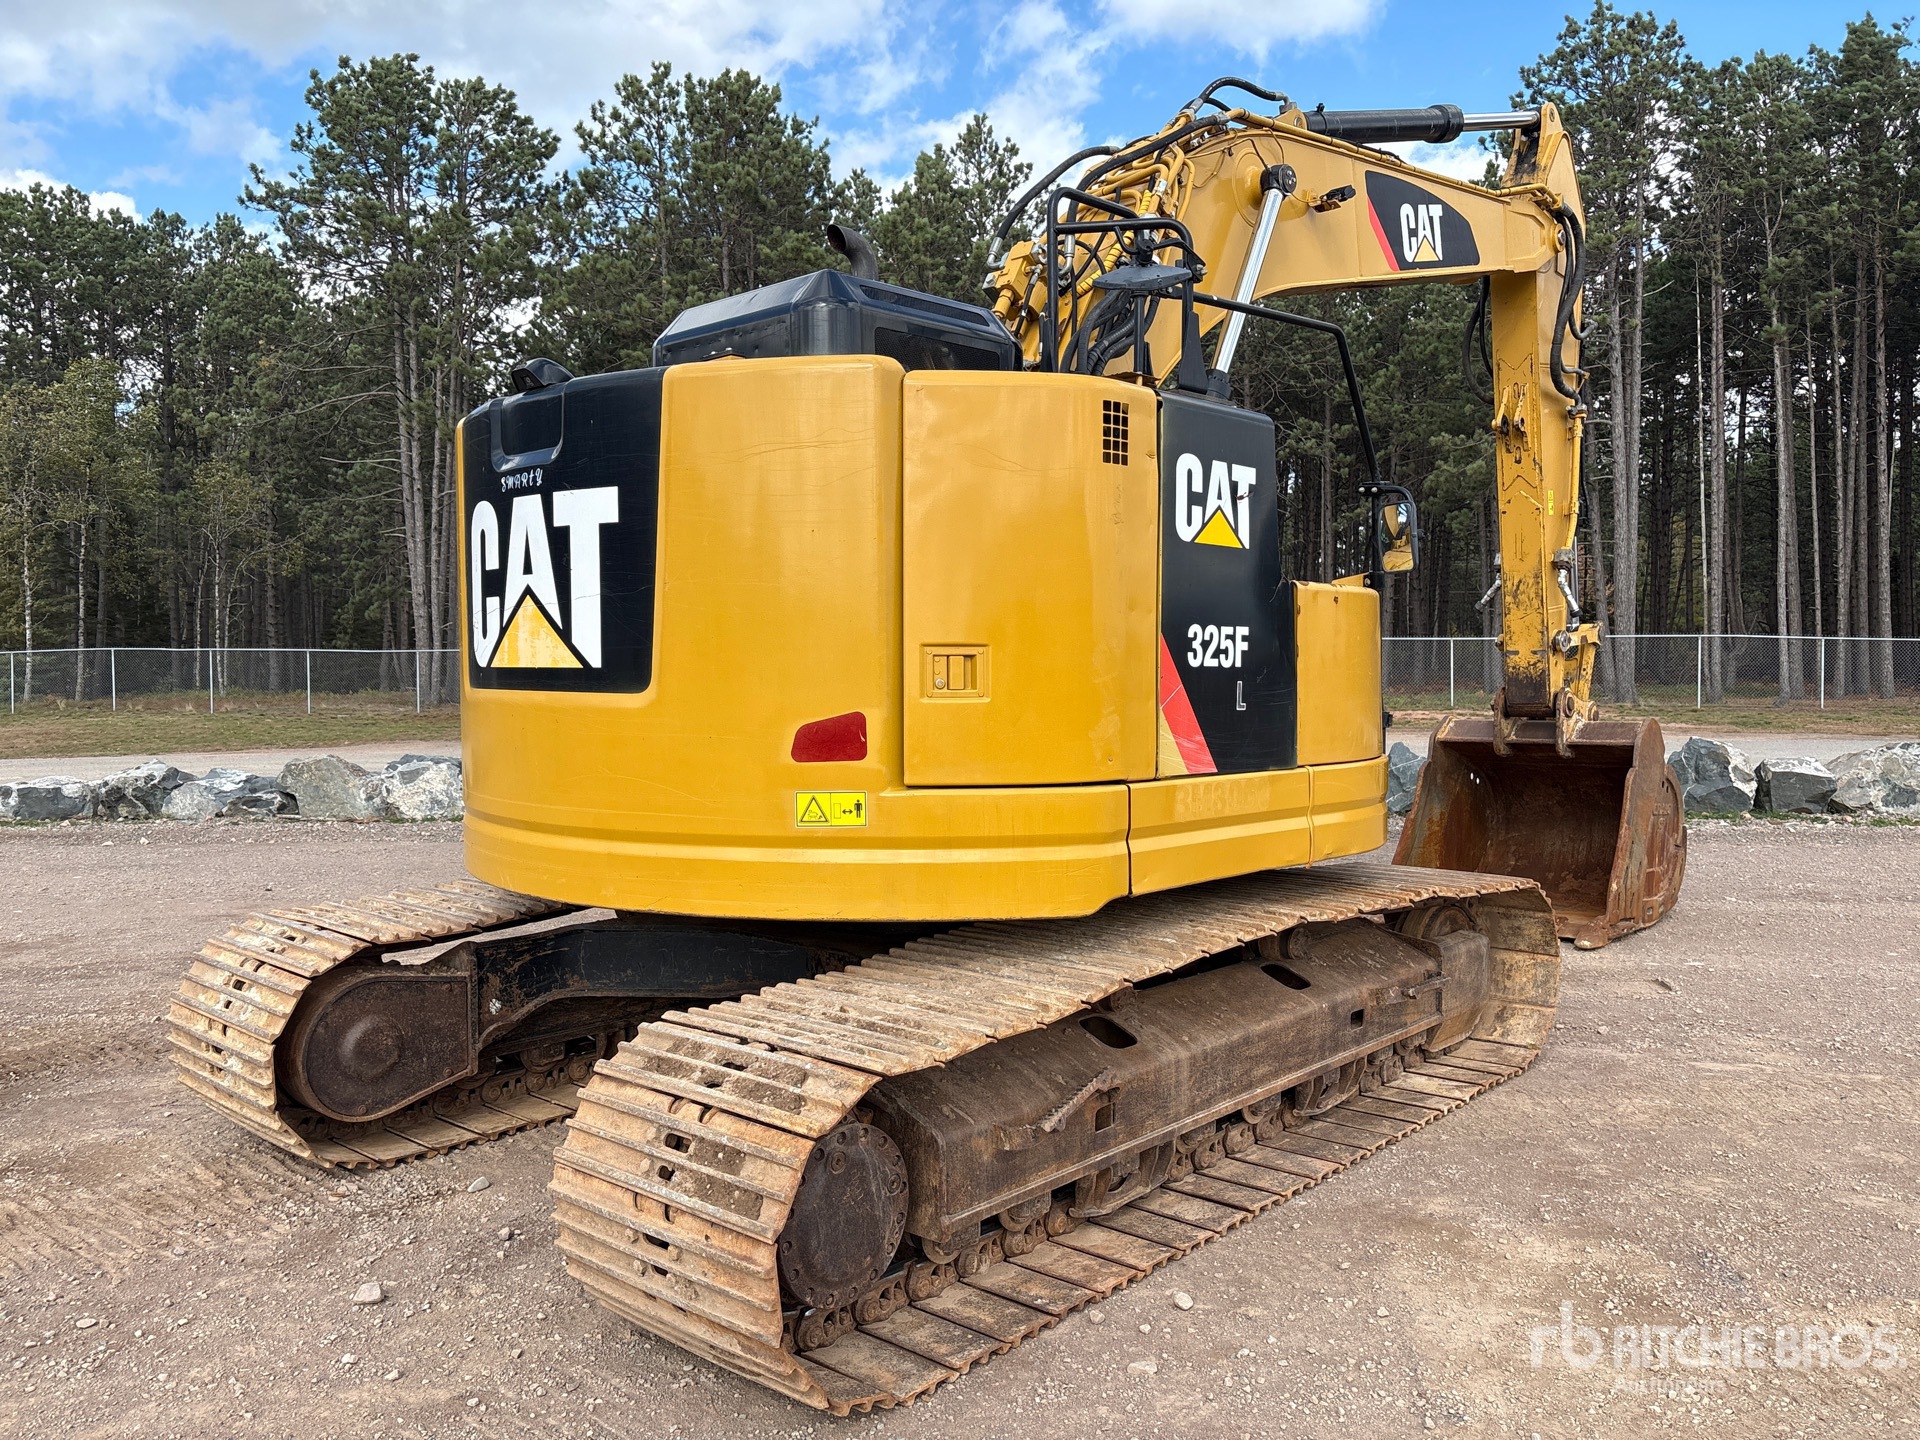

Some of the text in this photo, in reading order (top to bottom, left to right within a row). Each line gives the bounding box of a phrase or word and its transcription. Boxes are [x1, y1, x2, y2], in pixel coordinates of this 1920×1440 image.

[1400, 203, 1443, 263] CAT
[1175, 452, 1257, 550] CAT
[471, 486, 620, 669] CAT
[1187, 623, 1250, 669] 325F
[1236, 680, 1247, 711] L
